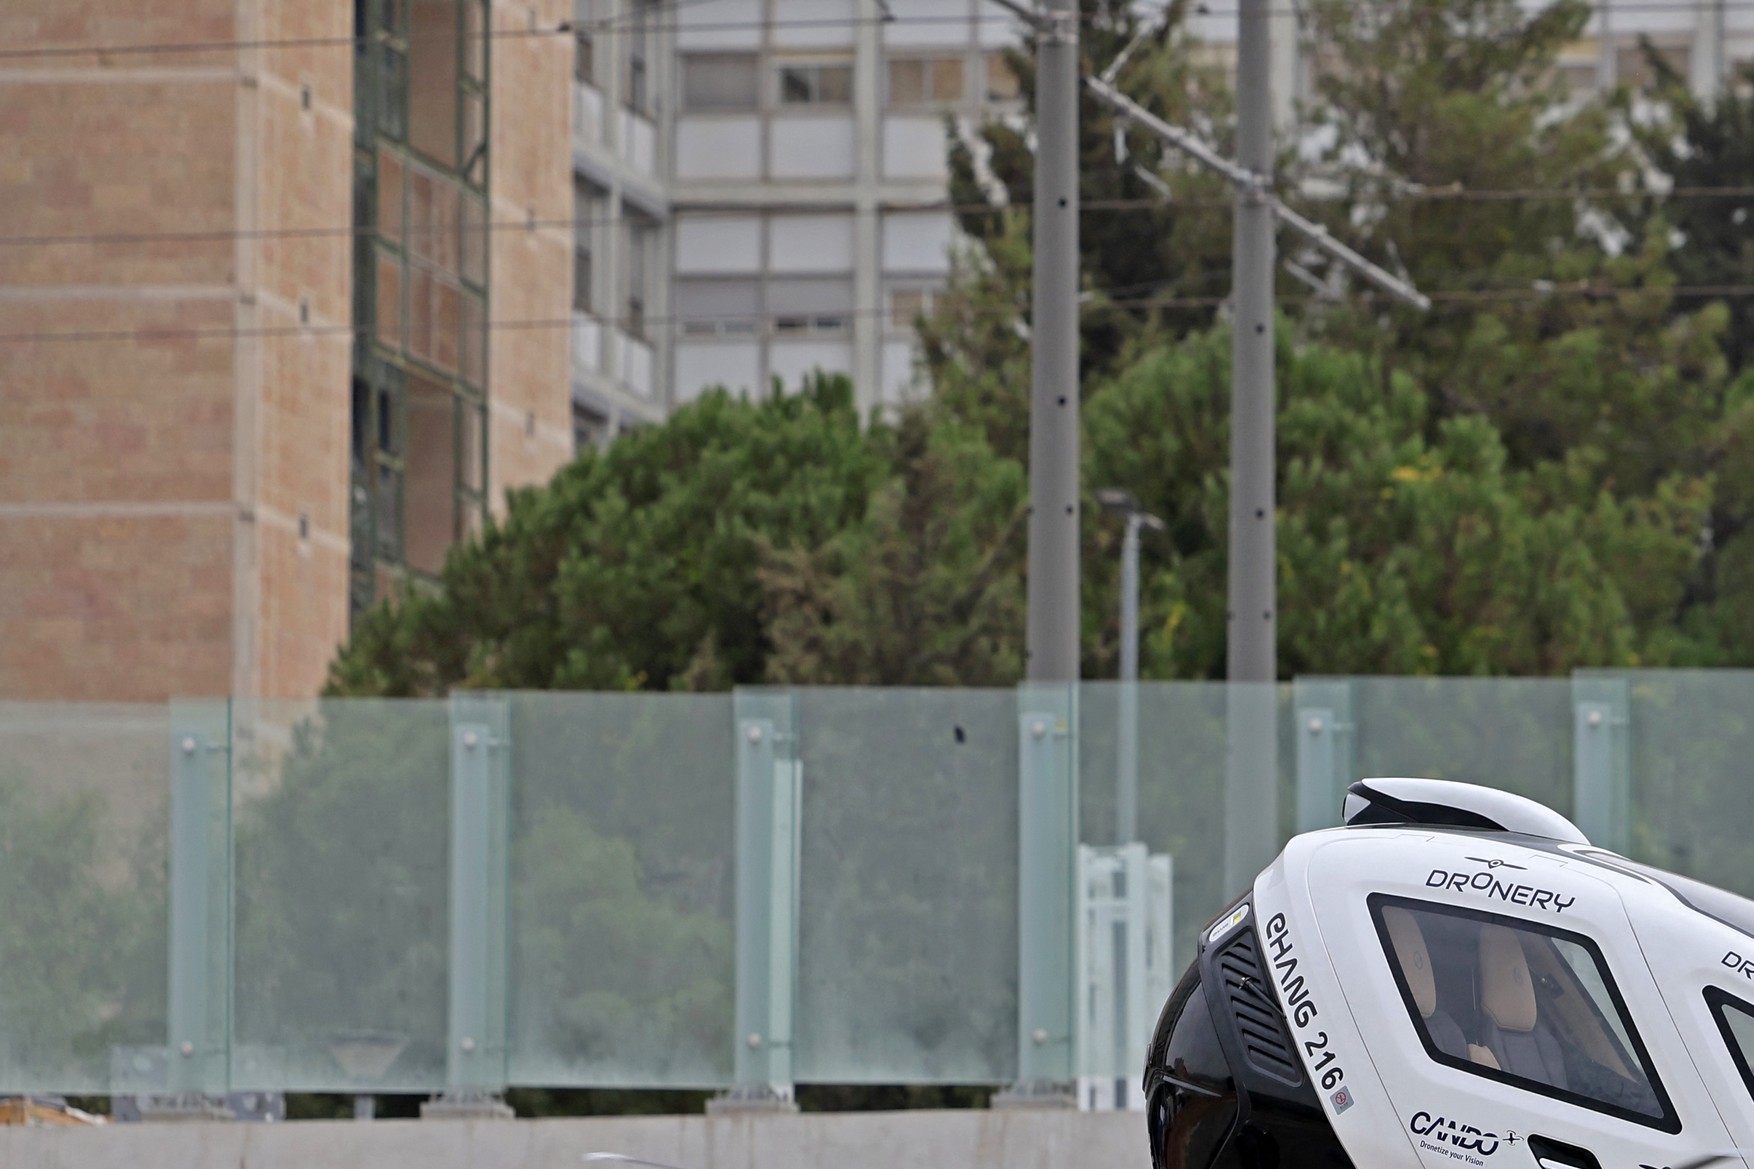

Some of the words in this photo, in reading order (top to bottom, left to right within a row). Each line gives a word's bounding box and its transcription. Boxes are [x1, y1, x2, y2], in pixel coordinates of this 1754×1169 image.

[1425, 869, 1576, 912] DRONERY
[1304, 1032, 1345, 1090] 216
[1409, 1111, 1500, 1156] CANDO
[1419, 1140, 1449, 1156] Dronetize
[1449, 1150, 1465, 1160] your
[1465, 1153, 1485, 1167] Vision
